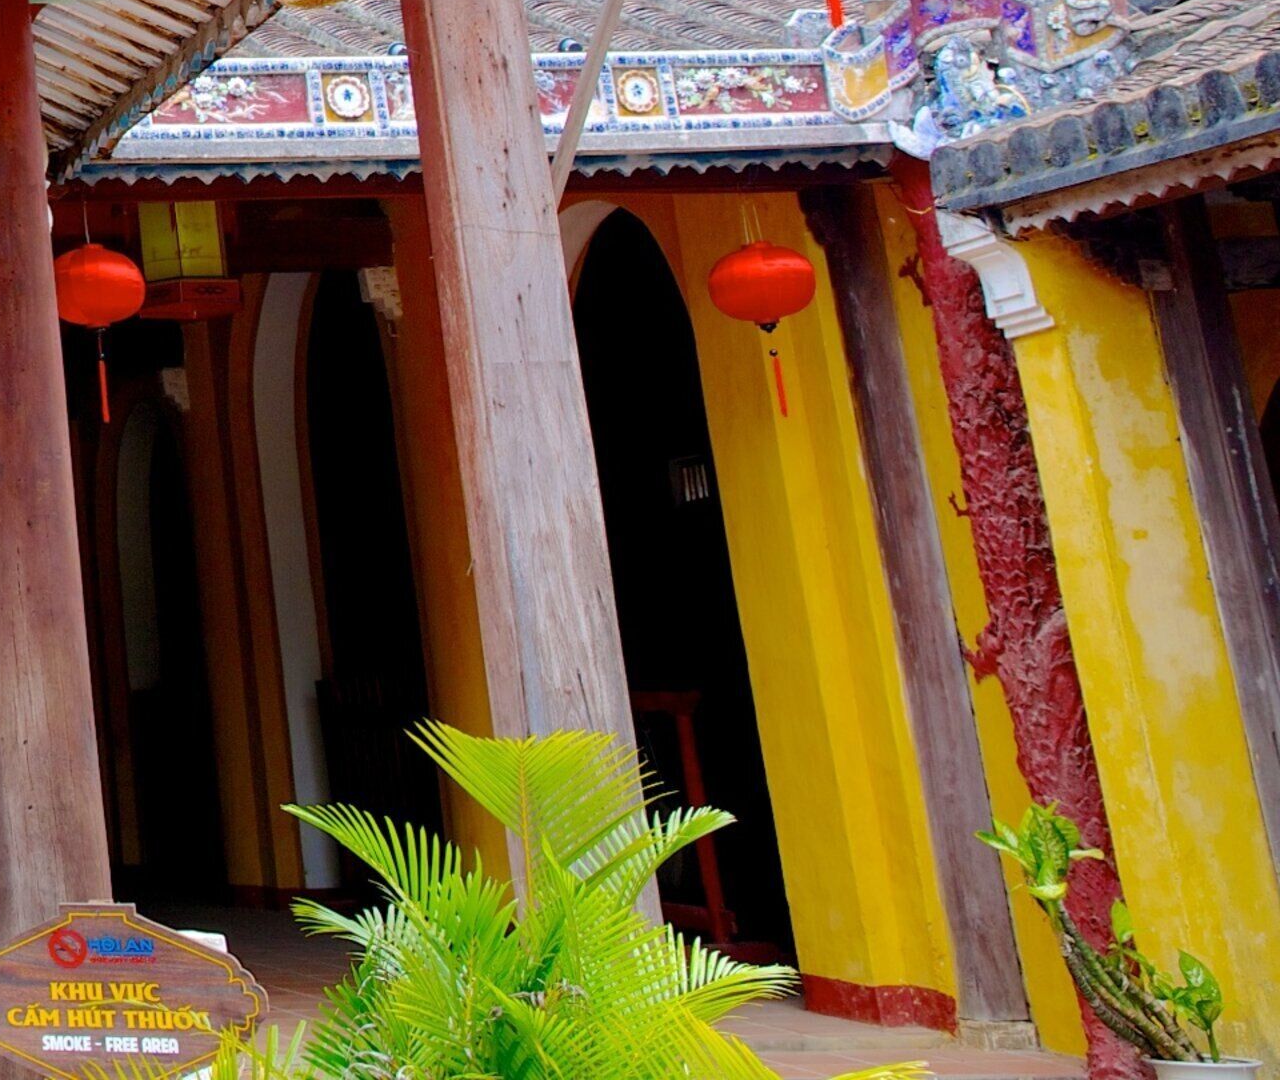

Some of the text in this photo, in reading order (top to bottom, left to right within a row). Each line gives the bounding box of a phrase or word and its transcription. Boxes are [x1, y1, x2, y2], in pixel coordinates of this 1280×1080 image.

[125, 936, 155, 953] AN
[49, 982, 104, 1001] KHU
[7, 1003, 60, 1028] CẤM
[66, 1007, 116, 1029] HÚT
[42, 1035, 92, 1052] SMOKE
[105, 1036, 138, 1053] FREE
[141, 1037, 180, 1054] AREA
